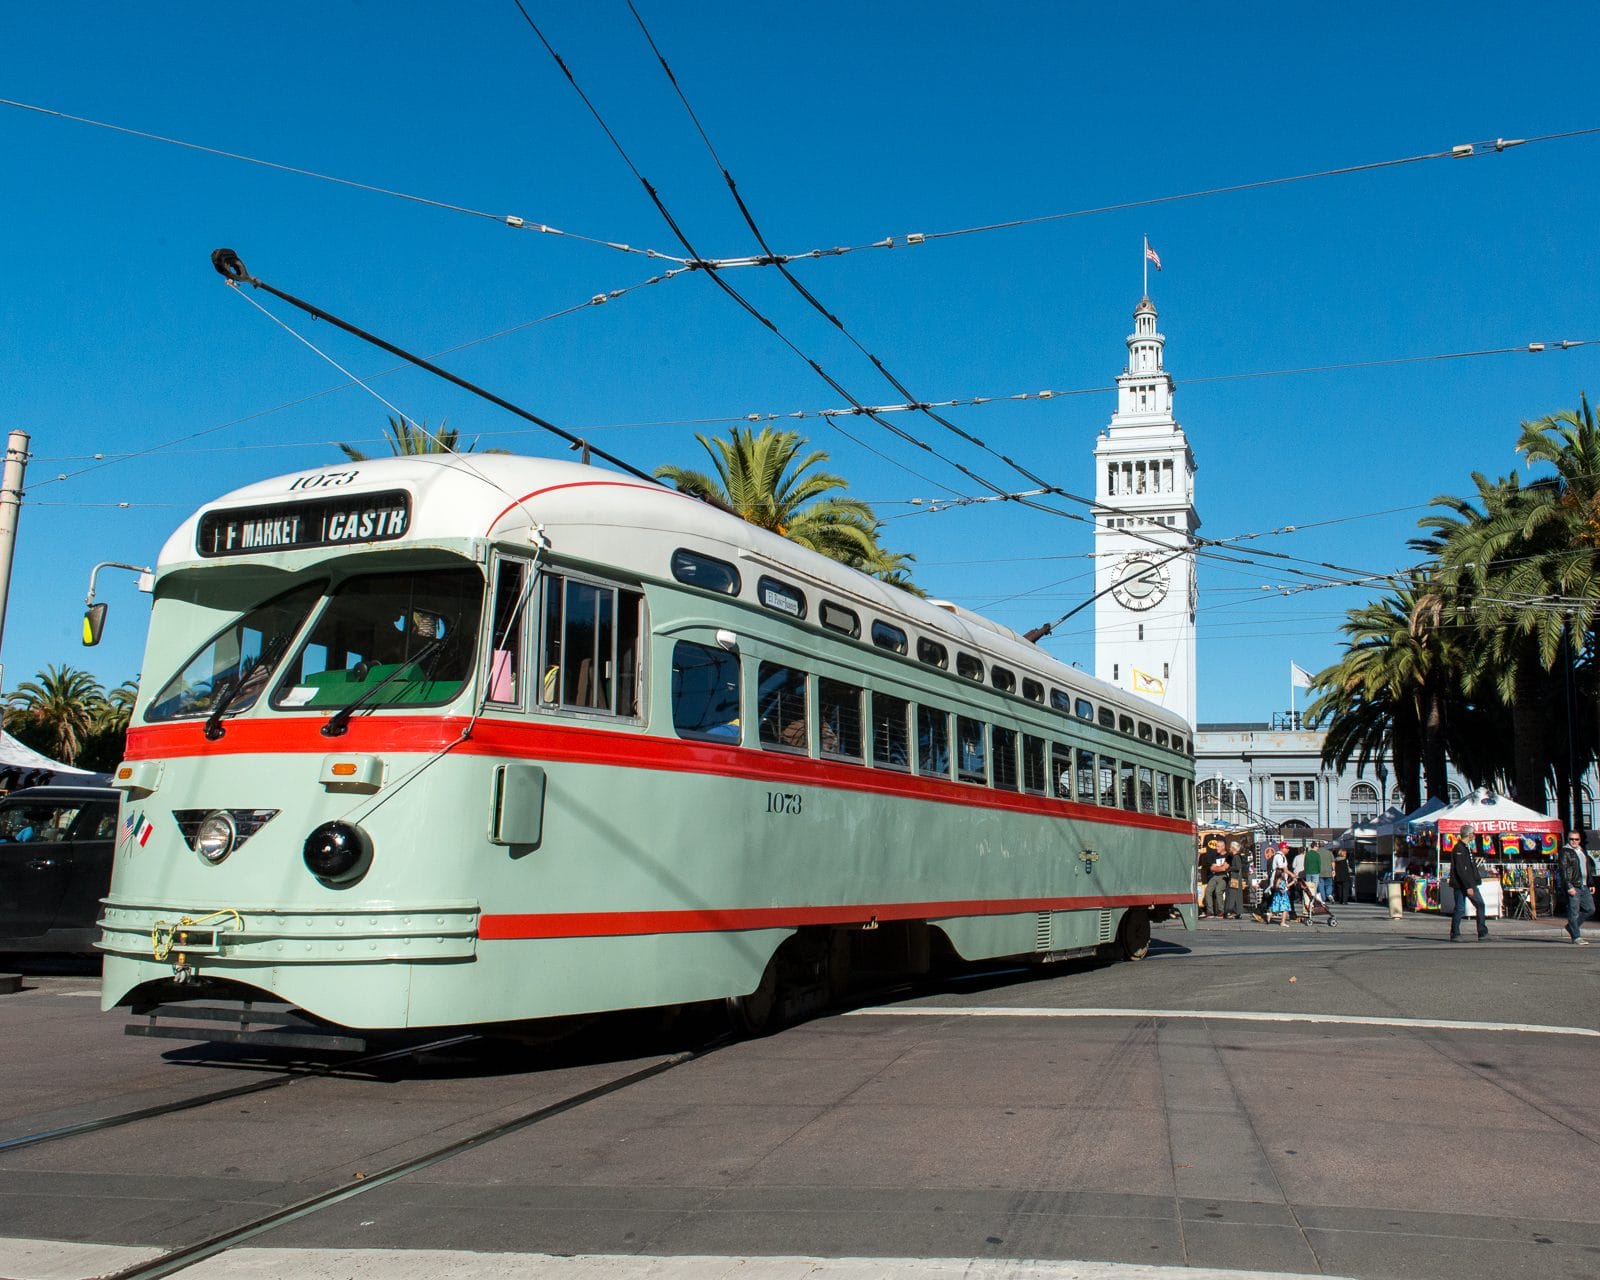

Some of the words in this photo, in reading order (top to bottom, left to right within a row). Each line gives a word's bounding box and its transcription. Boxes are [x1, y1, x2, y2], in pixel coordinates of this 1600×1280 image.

[288, 470, 360, 491] 1073
[241, 516, 300, 548] MARKET
[327, 507, 407, 540] CASTR
[765, 791, 802, 815] 1073
[1481, 820, 1518, 832] TIE-DYE
